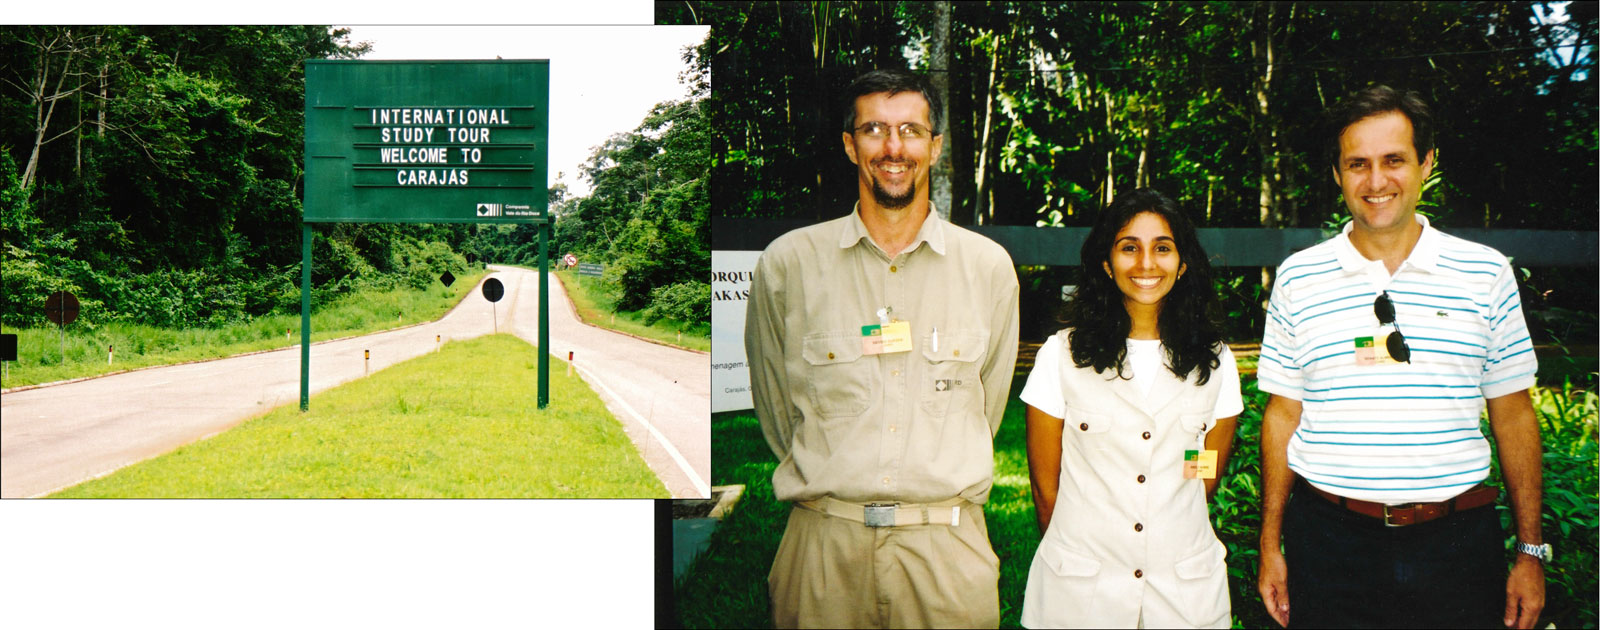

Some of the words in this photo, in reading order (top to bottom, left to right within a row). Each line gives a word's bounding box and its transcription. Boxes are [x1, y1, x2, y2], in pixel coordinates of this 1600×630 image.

[372, 109, 510, 124] INTERNATIONAL
[381, 127, 435, 143] STUDY
[448, 127, 490, 143] TOUR
[380, 148, 448, 163] WELCOME
[461, 148, 482, 163] TO
